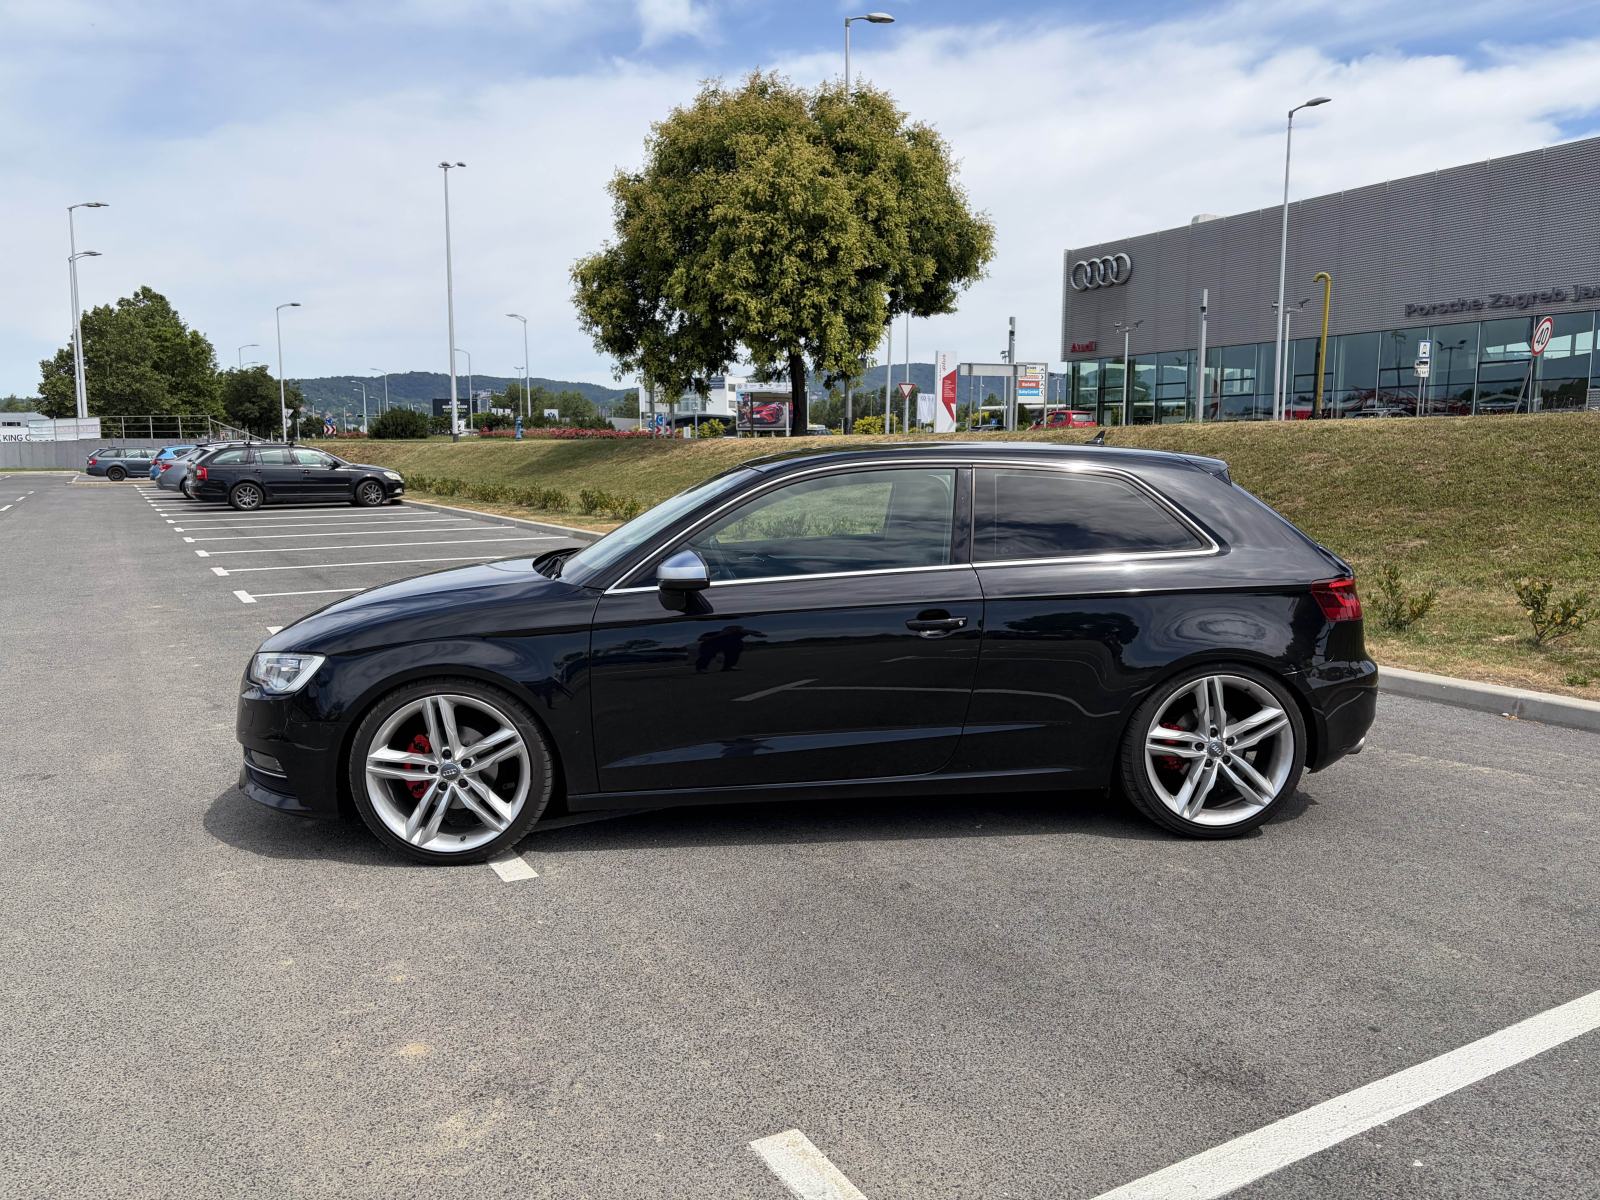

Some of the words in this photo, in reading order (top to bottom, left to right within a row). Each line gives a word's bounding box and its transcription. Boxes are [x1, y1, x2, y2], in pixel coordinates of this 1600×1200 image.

[1404, 297, 1484, 317] Porsche
[1488, 287, 1565, 309] Zagreb
[1535, 327, 1549, 346] 40
[1071, 340, 1096, 352] Audi
[3, 434, 23, 442] KING
